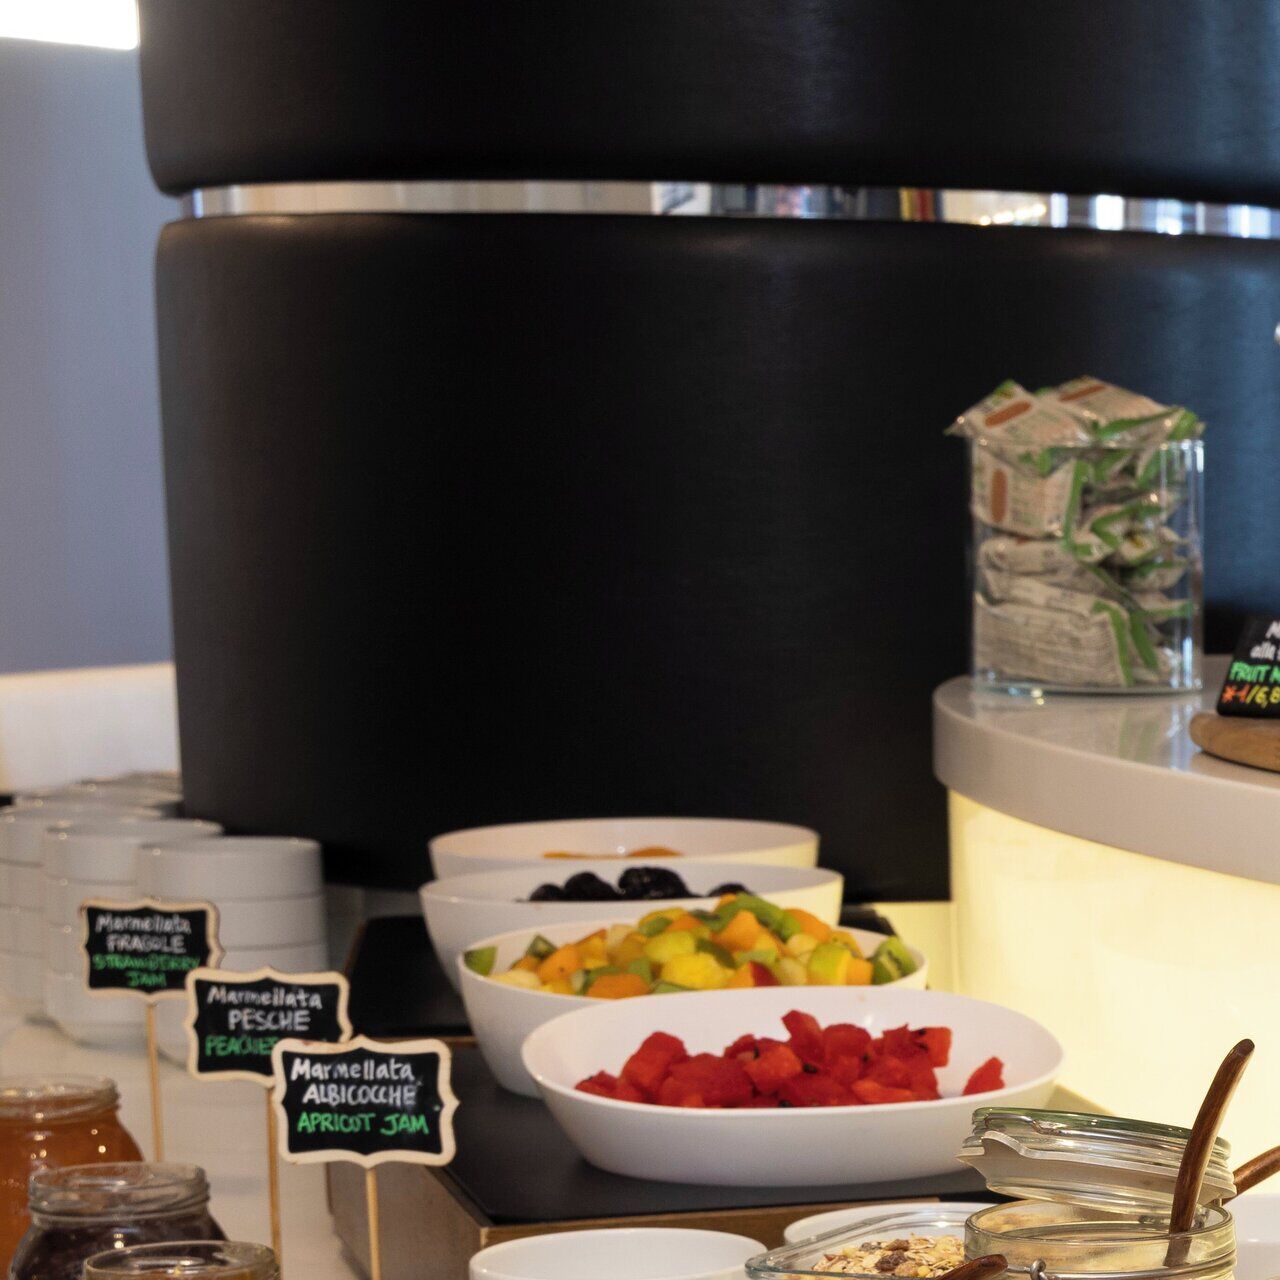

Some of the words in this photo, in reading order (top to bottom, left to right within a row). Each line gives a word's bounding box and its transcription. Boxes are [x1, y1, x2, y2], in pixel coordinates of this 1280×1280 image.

[1229, 661, 1271, 682] FRUIT
[207, 985, 323, 1010] Marmellata
[228, 1008, 311, 1031] PESCHE
[290, 1058, 415, 1082] Marmellata
[302, 1083, 417, 1107] ALBICOCCHE
[297, 1111, 376, 1134] APRICOT
[380, 1113, 430, 1136] JAM
